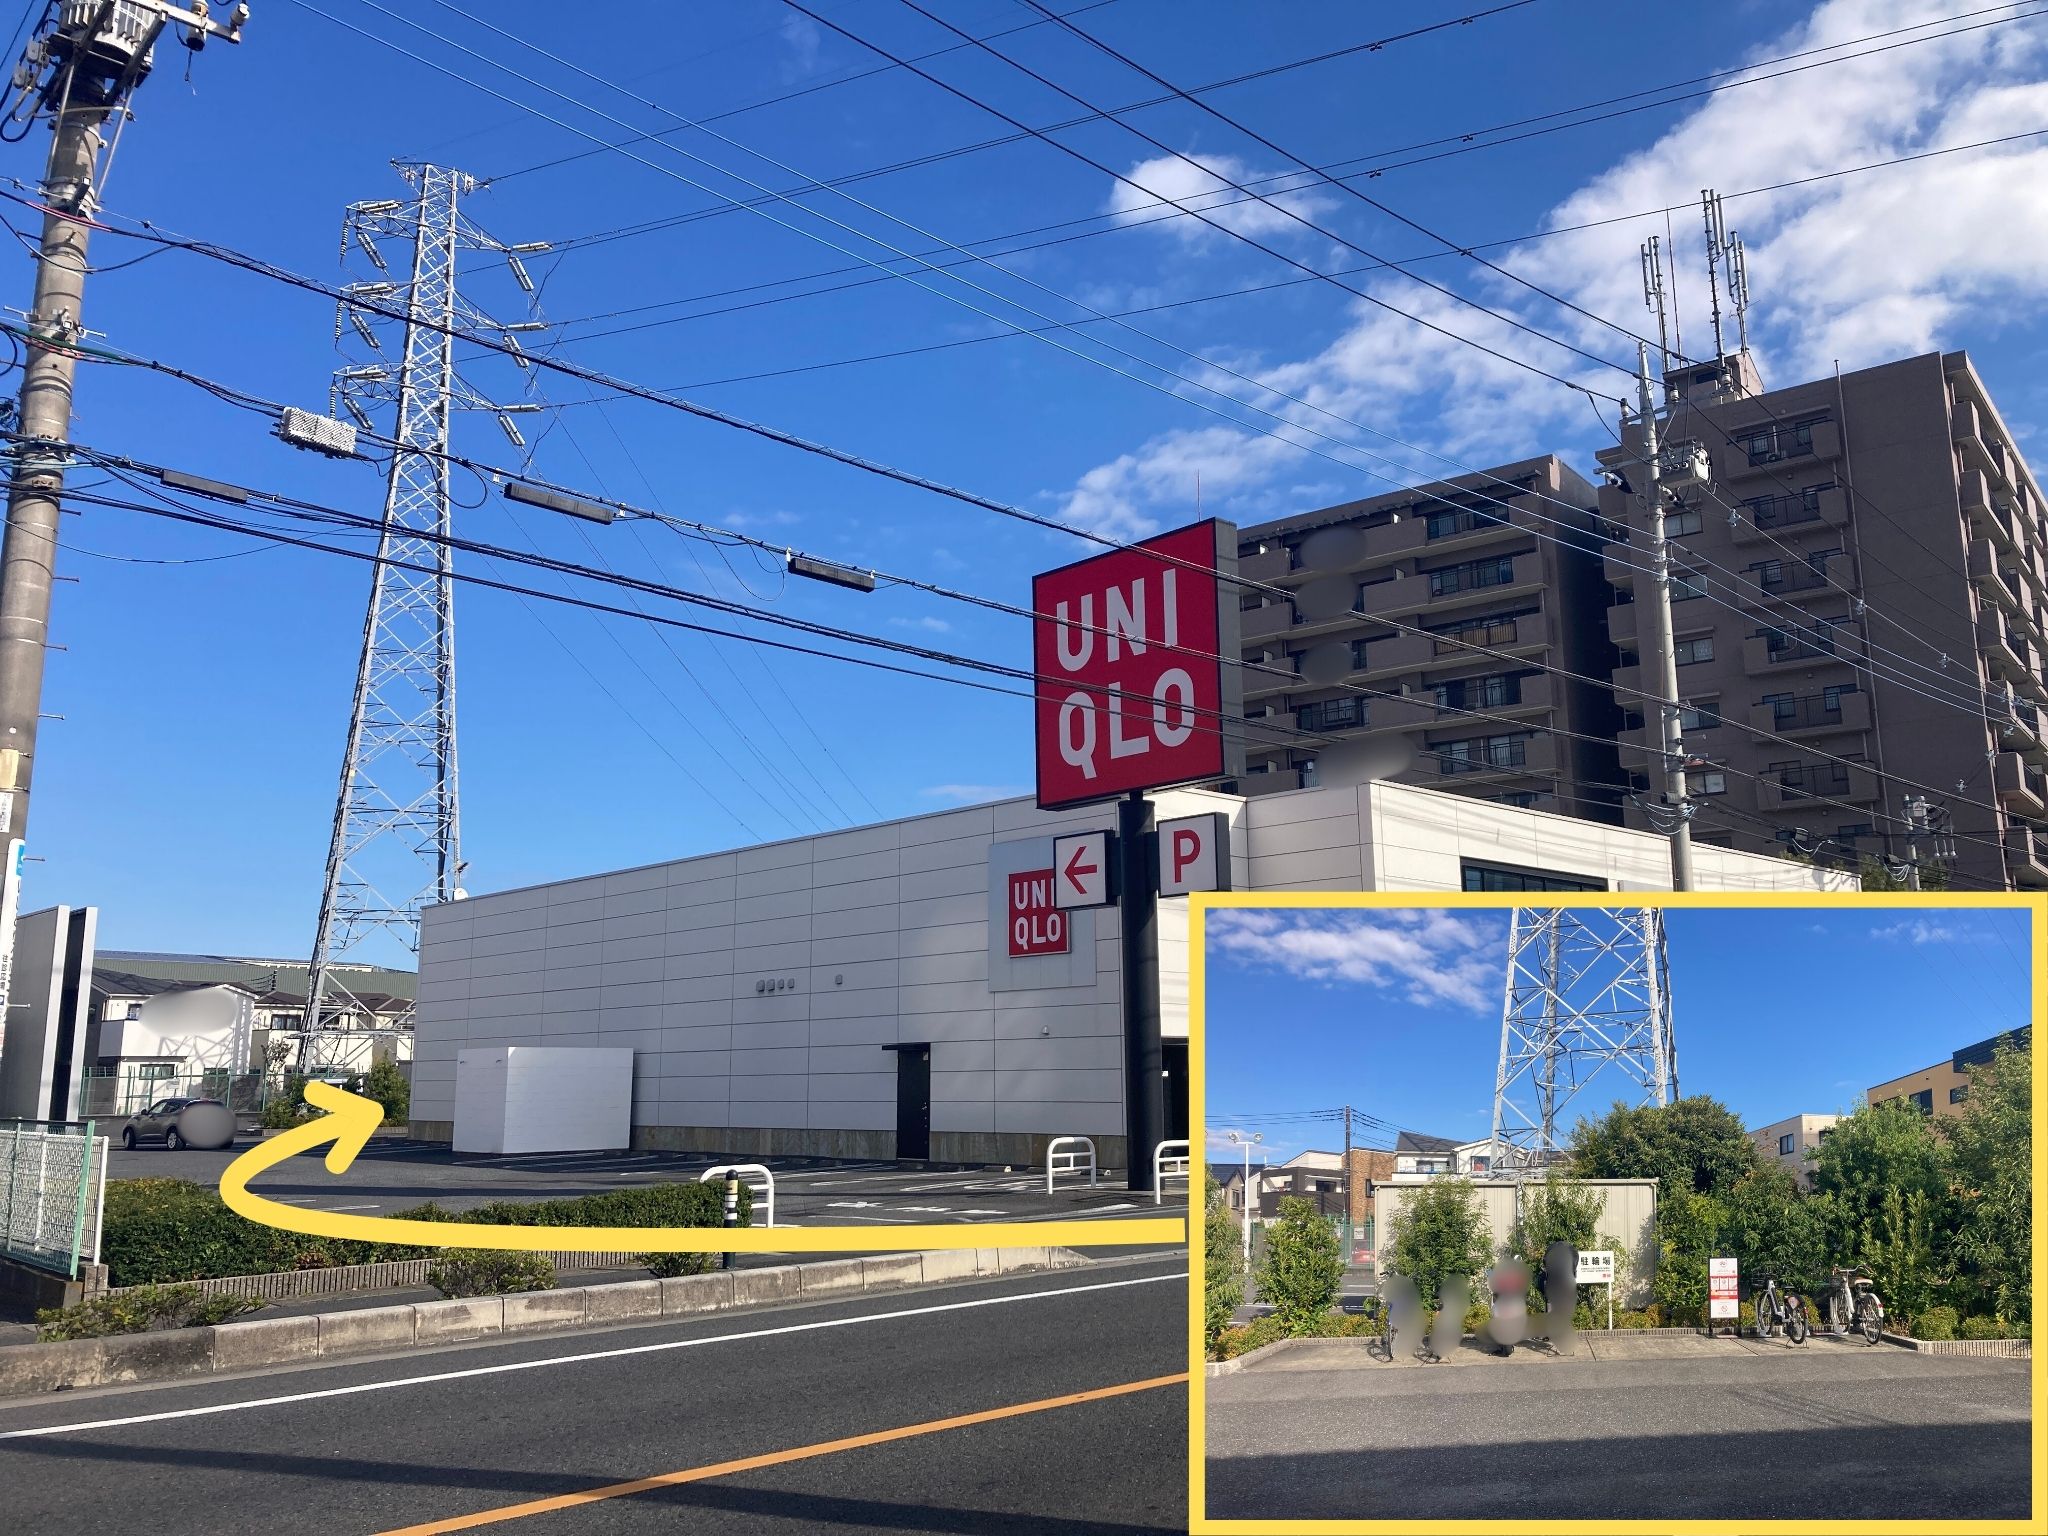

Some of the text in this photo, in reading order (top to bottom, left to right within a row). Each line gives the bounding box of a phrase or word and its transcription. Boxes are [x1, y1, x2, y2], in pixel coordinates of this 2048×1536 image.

[1056, 568, 1178, 672] UNI
[1058, 668, 1195, 780] QLO
[1173, 829, 1200, 883] P
[1014, 878, 1055, 910] UNI
[1014, 914, 1061, 950] QLO
[1580, 1256, 1611, 1266] 駐輪場
